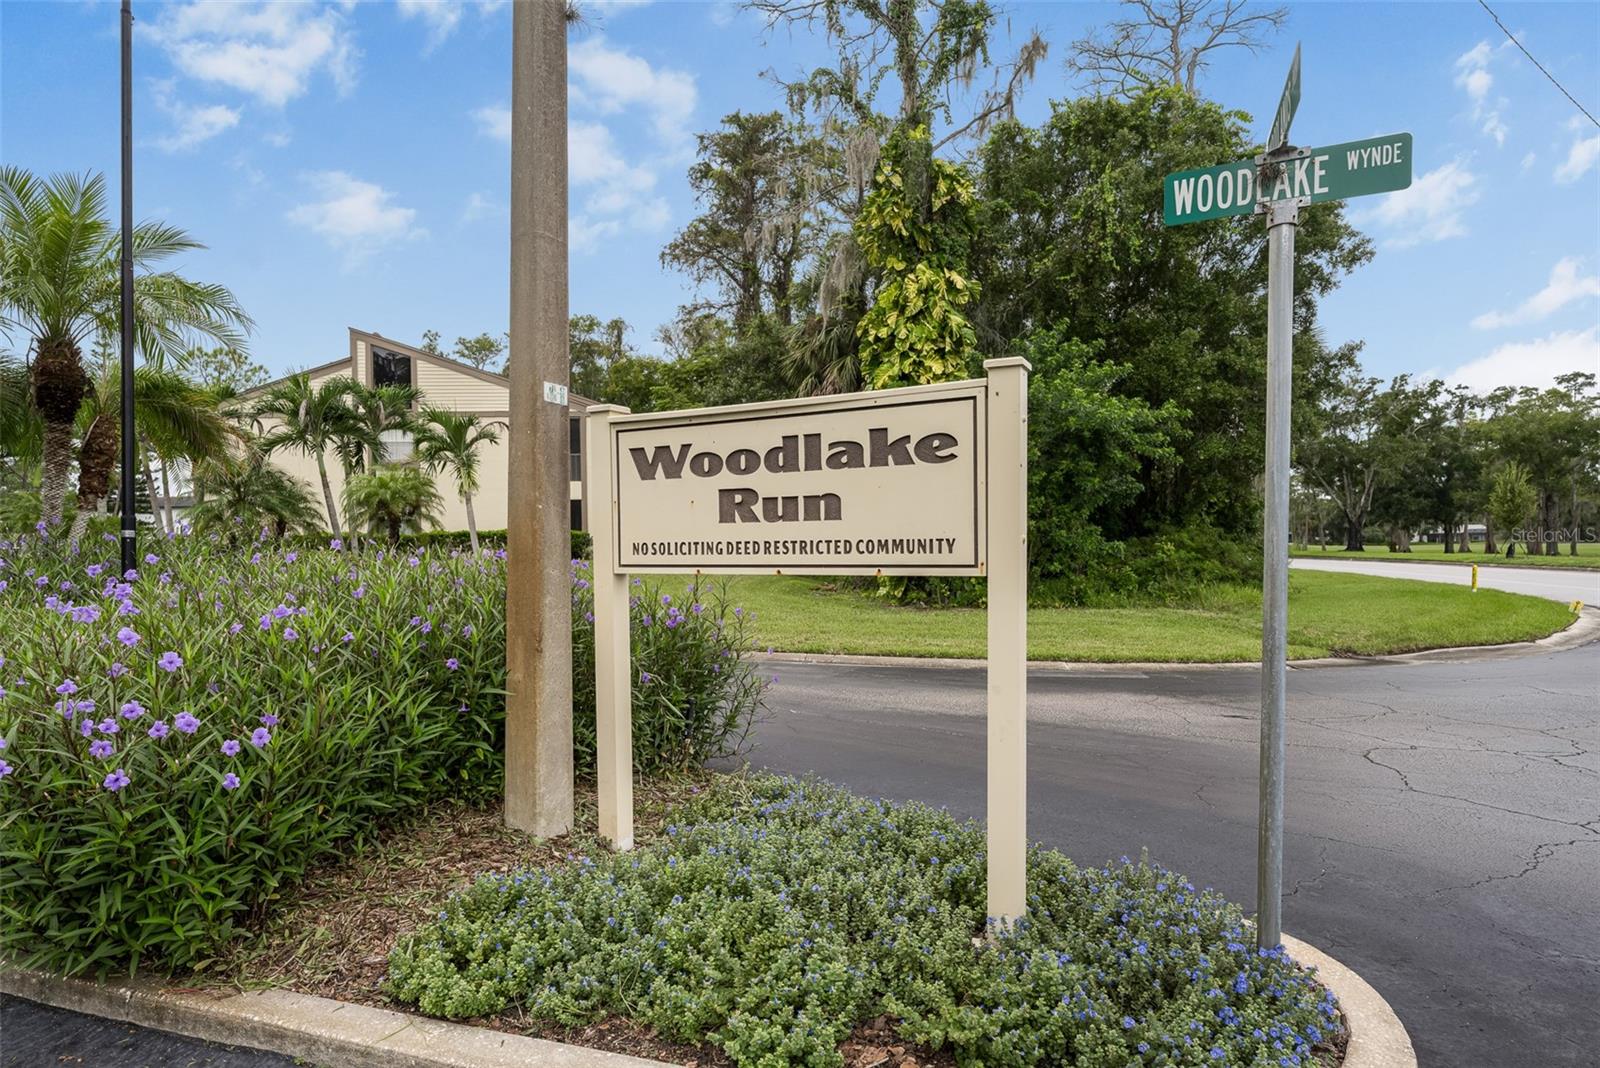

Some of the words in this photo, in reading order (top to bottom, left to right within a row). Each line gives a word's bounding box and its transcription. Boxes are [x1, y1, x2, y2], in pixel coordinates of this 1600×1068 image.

[1173, 154, 1329, 216] WOODLAKE
[1346, 142, 1404, 171] WYNDE
[628, 427, 959, 481] Woodlake
[718, 487, 843, 524] Run
[632, 542, 649, 556] NO
[650, 541, 724, 556] SOLICITING
[726, 540, 760, 556] DEED
[763, 539, 853, 555] RESTRICTED
[856, 537, 957, 555] COMMUNITY
